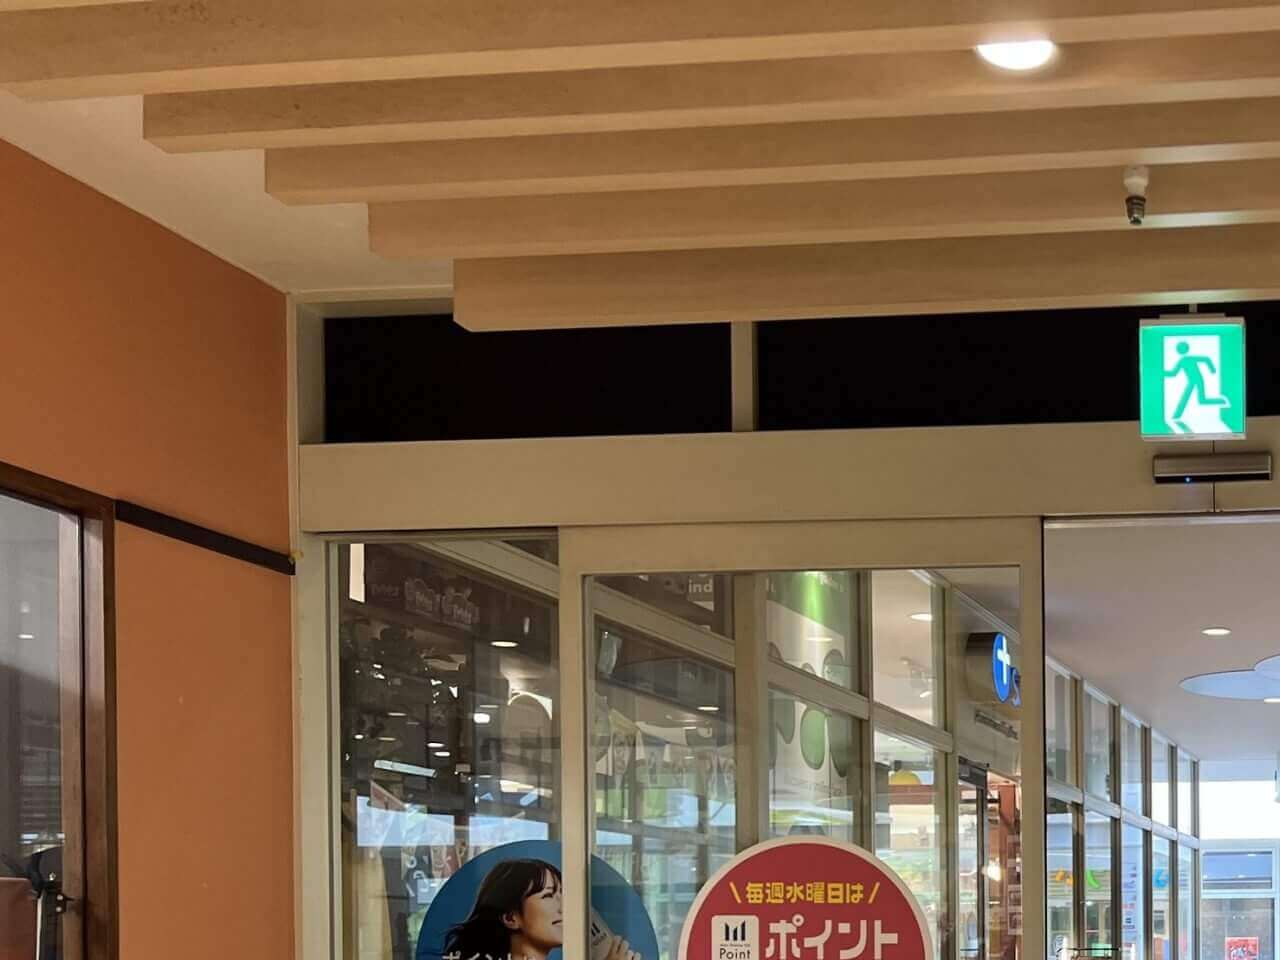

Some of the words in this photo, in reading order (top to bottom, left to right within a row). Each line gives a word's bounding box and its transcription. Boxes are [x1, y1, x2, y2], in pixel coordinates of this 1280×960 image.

[746, 882, 865, 904] 毎週水曜日は
[765, 914, 898, 960] ポイント
[719, 947, 751, 960] Point
